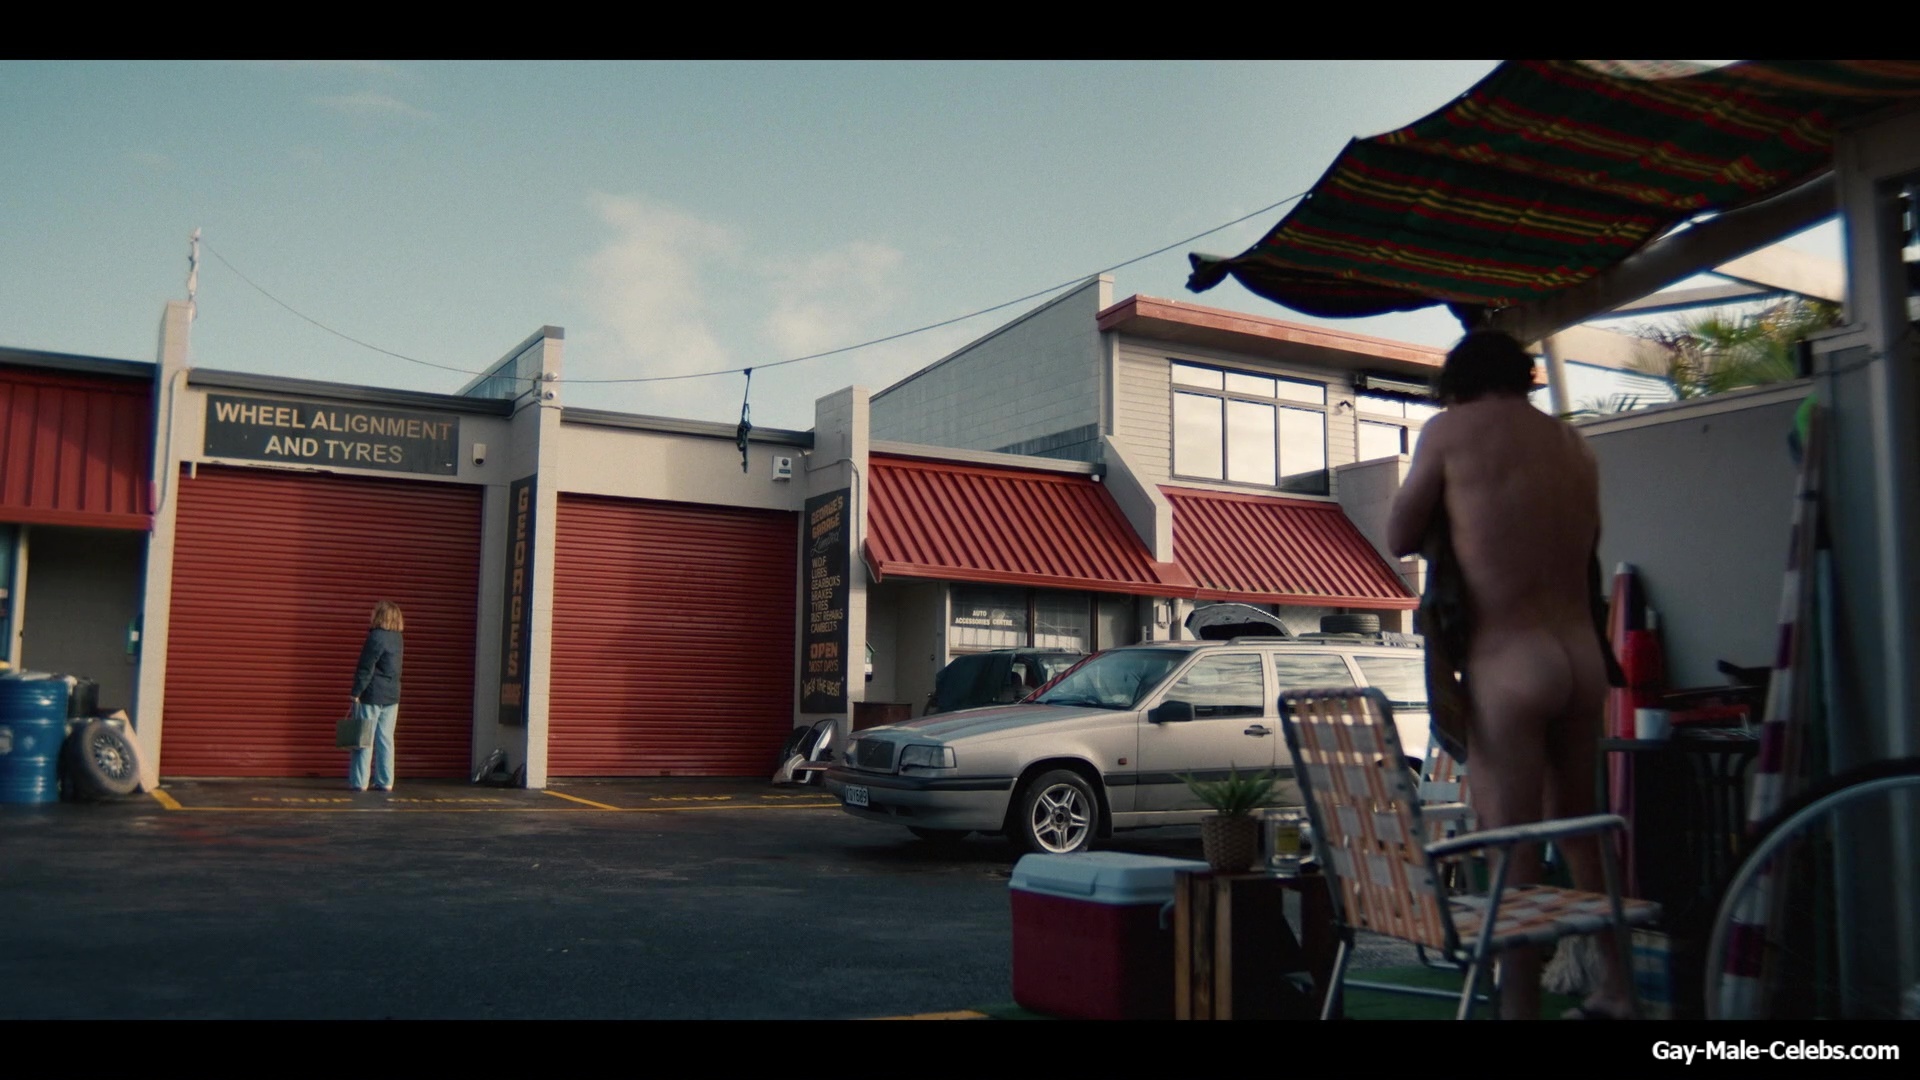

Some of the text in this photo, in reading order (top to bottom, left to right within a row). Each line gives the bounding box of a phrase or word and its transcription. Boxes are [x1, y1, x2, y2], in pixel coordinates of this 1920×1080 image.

[215, 402, 452, 440] WHEEL ALIGNMENT
[264, 435, 403, 464] AND TYRES
[811, 512, 840, 540] GARAGE
[811, 566, 828, 579] LUBES
[811, 587, 833, 602] BRAKES
[811, 600, 829, 612] TYRES
[811, 612, 823, 623] RUST
[955, 617, 1013, 627] ACCESSORIES CENTRE
[810, 642, 838, 659] OPEN
